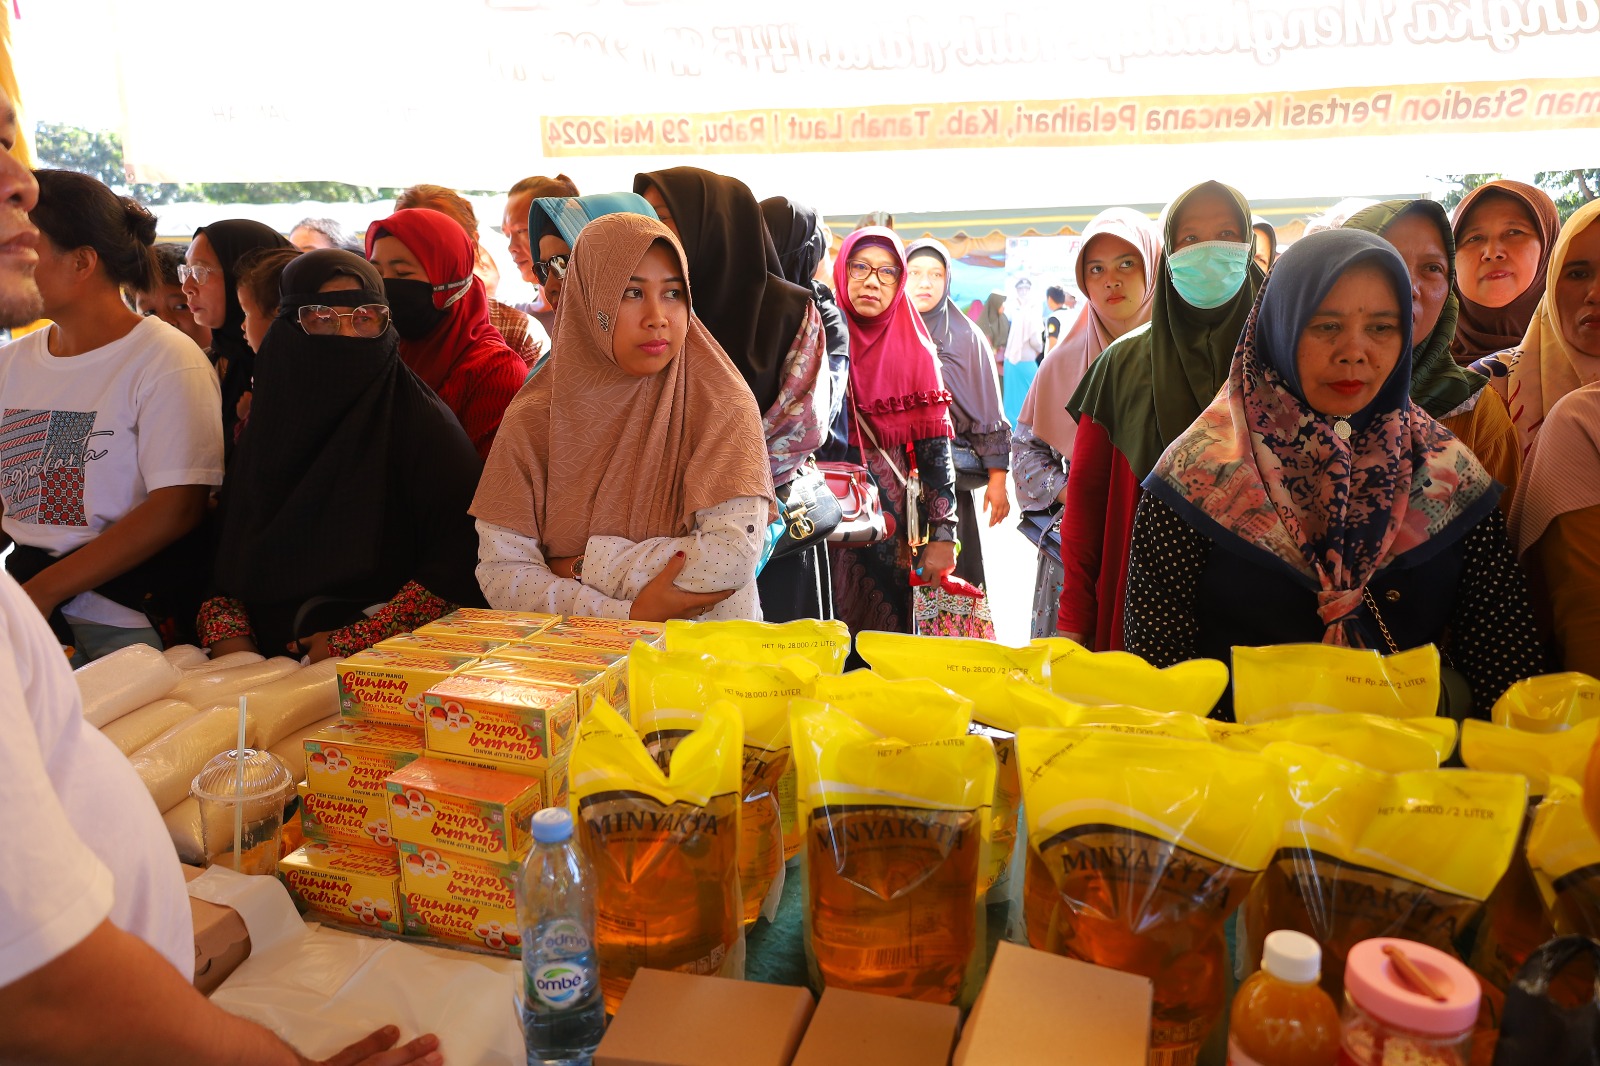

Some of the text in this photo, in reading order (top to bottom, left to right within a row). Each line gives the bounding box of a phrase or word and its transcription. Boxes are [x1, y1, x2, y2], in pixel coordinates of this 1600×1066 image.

[0, 430, 114, 503] ogjakarta
[947, 664, 959, 672] HET
[342, 671, 408, 695] Gunung
[1346, 676, 1361, 684] HET
[1405, 677, 1426, 688] LITER
[349, 688, 404, 706] Satria
[781, 688, 801, 697] LITER
[473, 720, 535, 740] Satria
[468, 732, 543, 761] Gunung
[303, 793, 368, 819] Gunung
[345, 796, 364, 804] WANGI
[310, 811, 364, 829] Satria
[435, 810, 496, 833] Satria
[1464, 808, 1495, 820] LITER
[430, 822, 504, 853] Gunung
[286, 869, 353, 897] Gunung
[310, 871, 328, 879] CELUP
[329, 874, 348, 882] WANGI
[452, 870, 513, 891] Satria
[298, 888, 348, 907] Satria
[406, 892, 479, 920] Gunung
[415, 911, 474, 931] Satria
